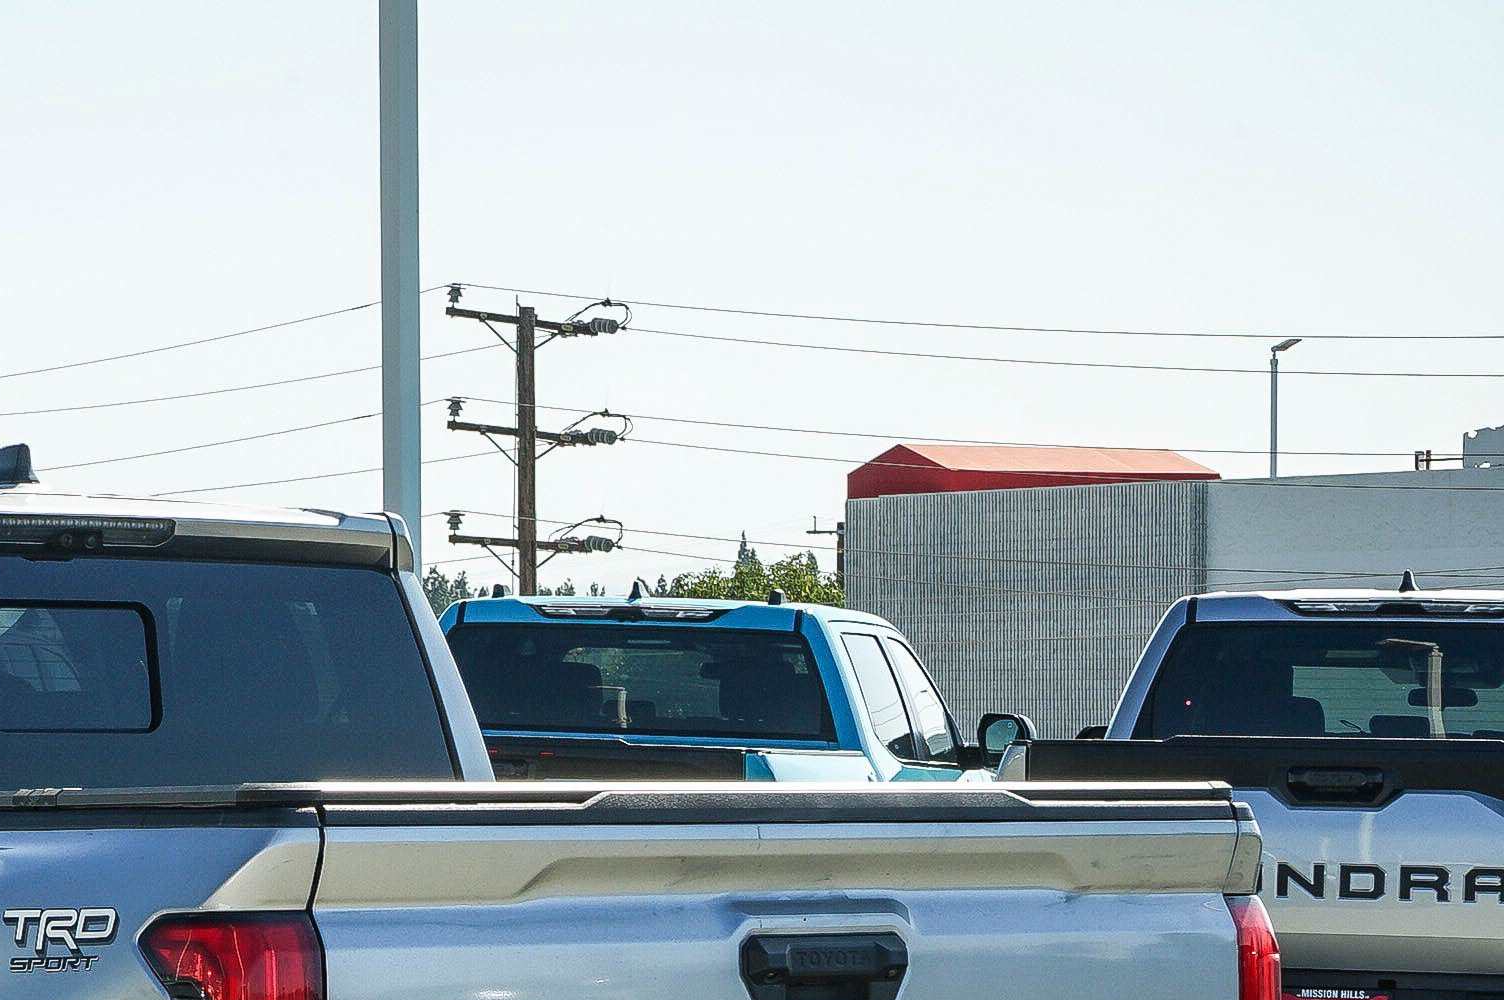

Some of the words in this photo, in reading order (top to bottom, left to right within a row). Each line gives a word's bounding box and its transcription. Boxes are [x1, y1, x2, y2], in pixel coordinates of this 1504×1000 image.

[1256, 862, 1504, 903] NDRA
[2, 907, 120, 956] TRD
[9, 956, 98, 973] SPORT
[1301, 989, 1338, 998] MISSION
[1340, 990, 1365, 999] HILLS
